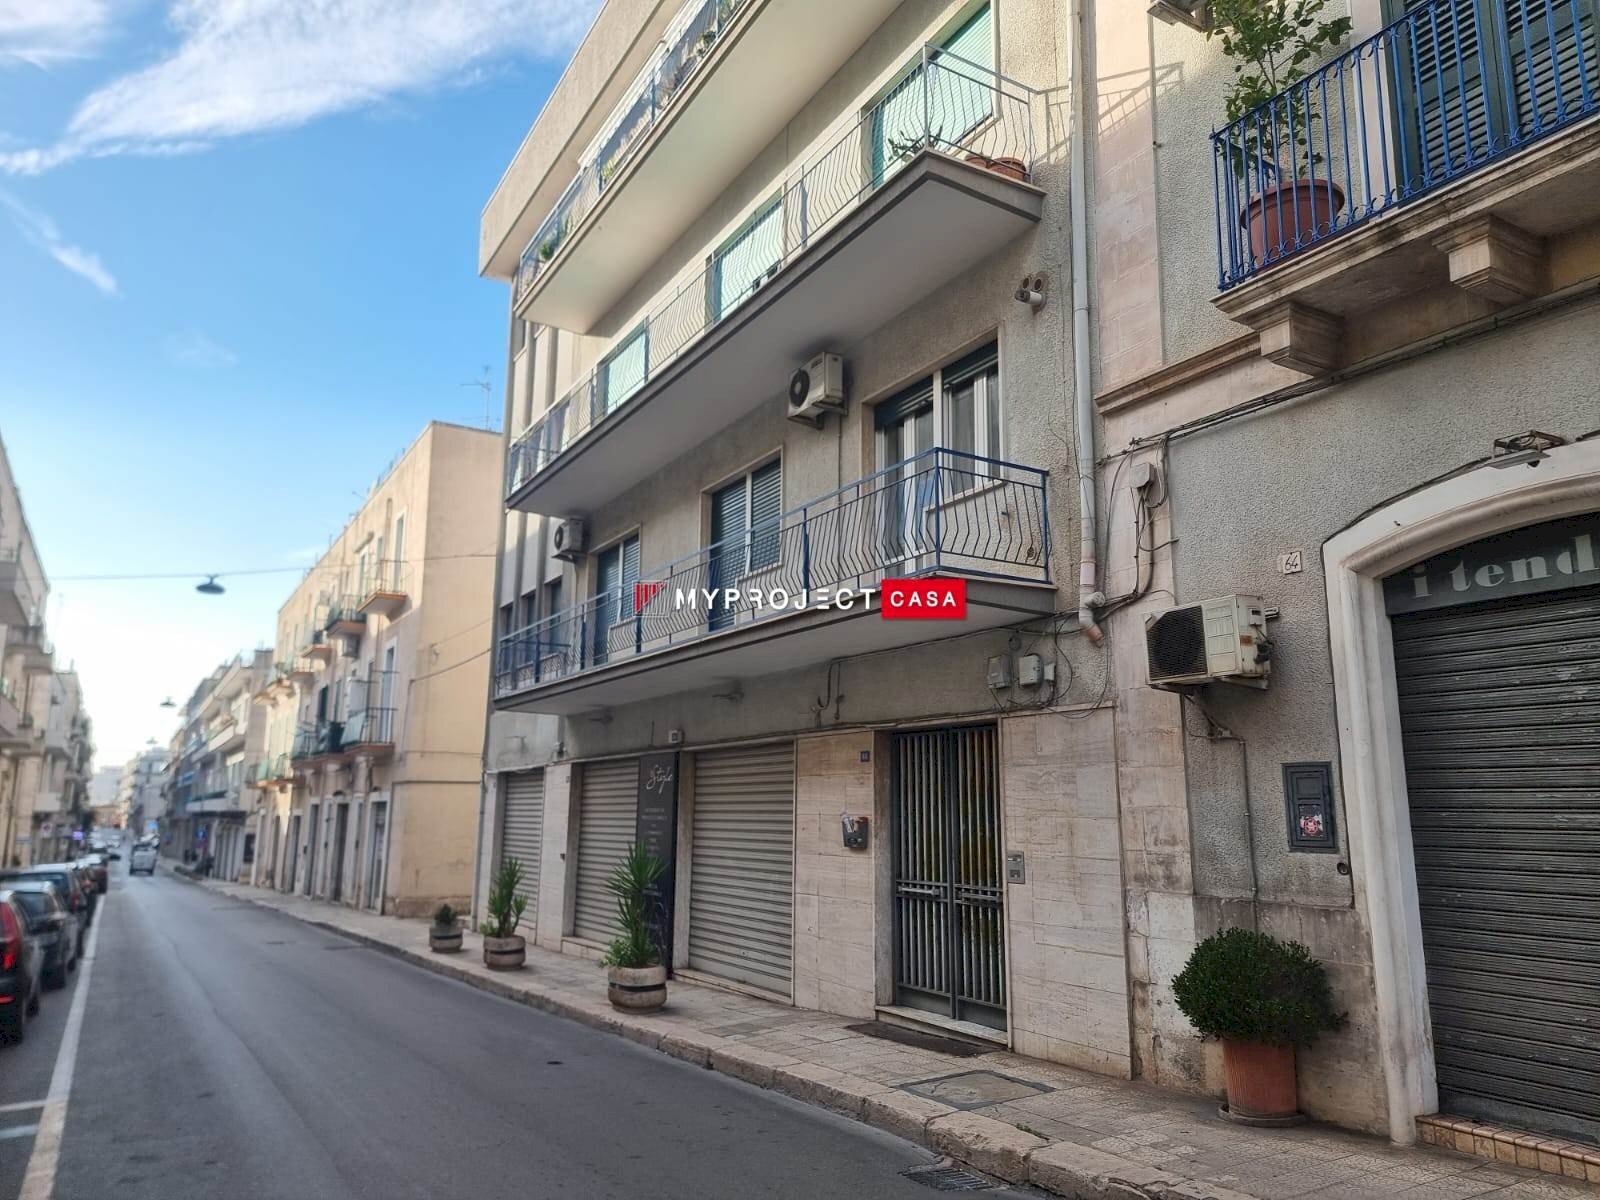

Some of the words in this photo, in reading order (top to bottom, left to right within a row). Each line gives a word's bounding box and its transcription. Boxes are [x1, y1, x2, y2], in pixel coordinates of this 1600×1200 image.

[1284, 554, 1299, 571] 64
[1412, 564, 1432, 599] i
[1449, 534, 1600, 593] tend
